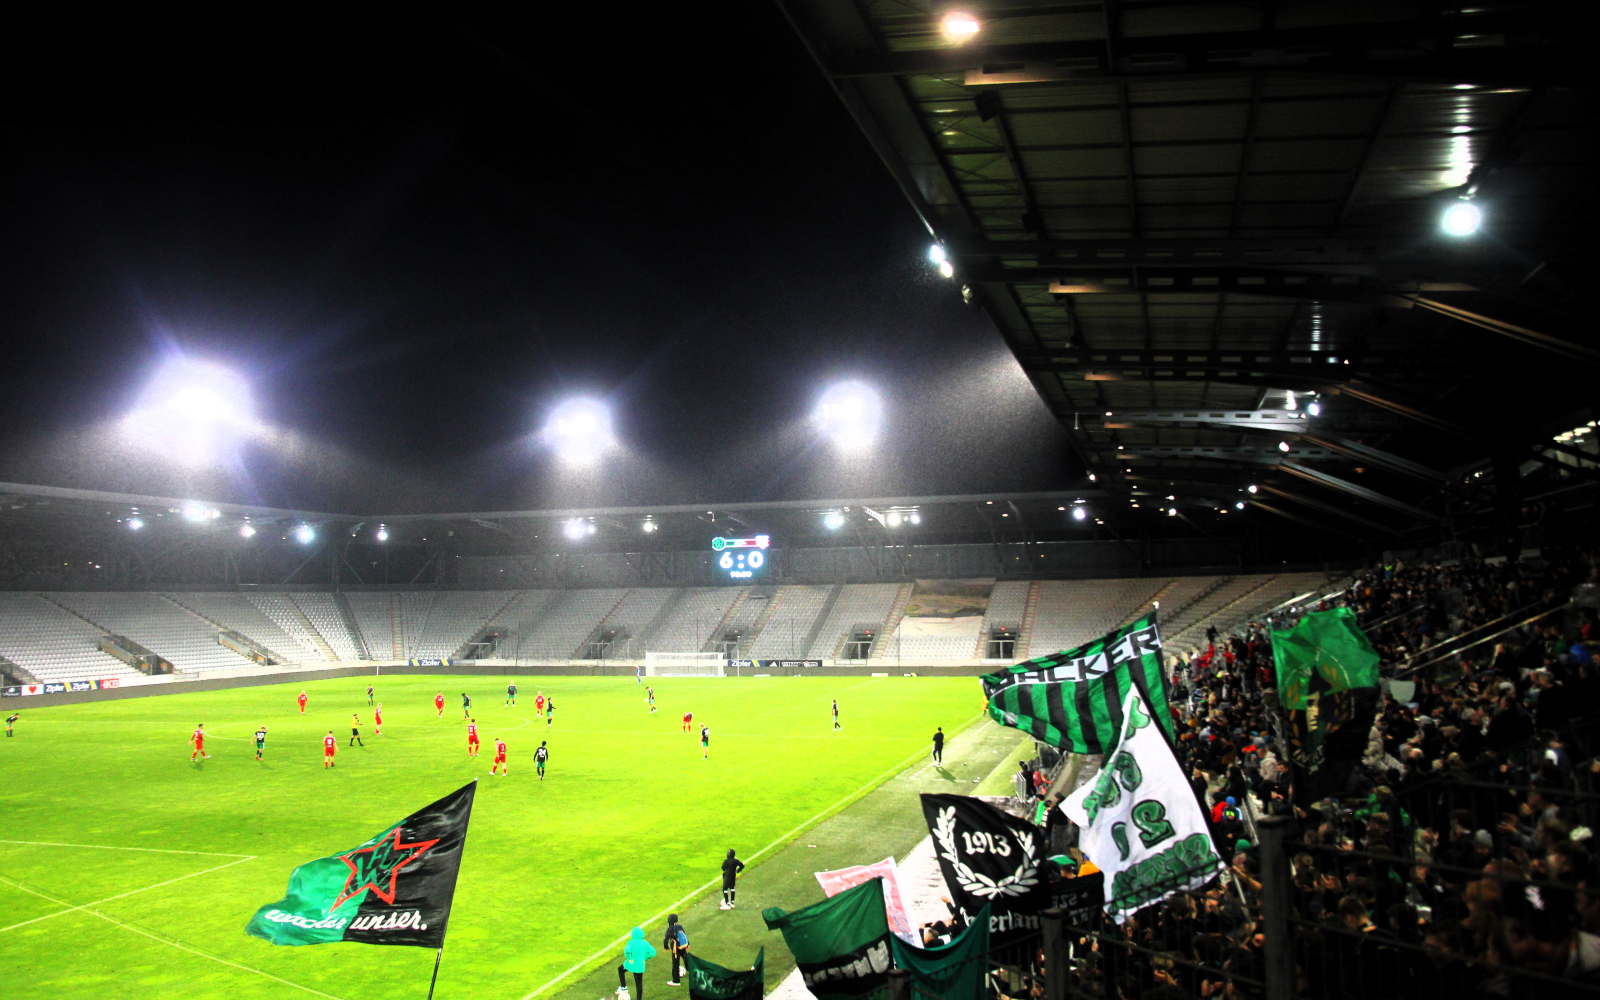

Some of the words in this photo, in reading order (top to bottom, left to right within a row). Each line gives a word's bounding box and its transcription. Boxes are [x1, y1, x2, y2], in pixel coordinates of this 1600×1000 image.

[46, 684, 65, 694] Zipfer
[72, 682, 90, 692] Zipfer
[962, 831, 1012, 857] 1913
[348, 910, 428, 931] unser.
